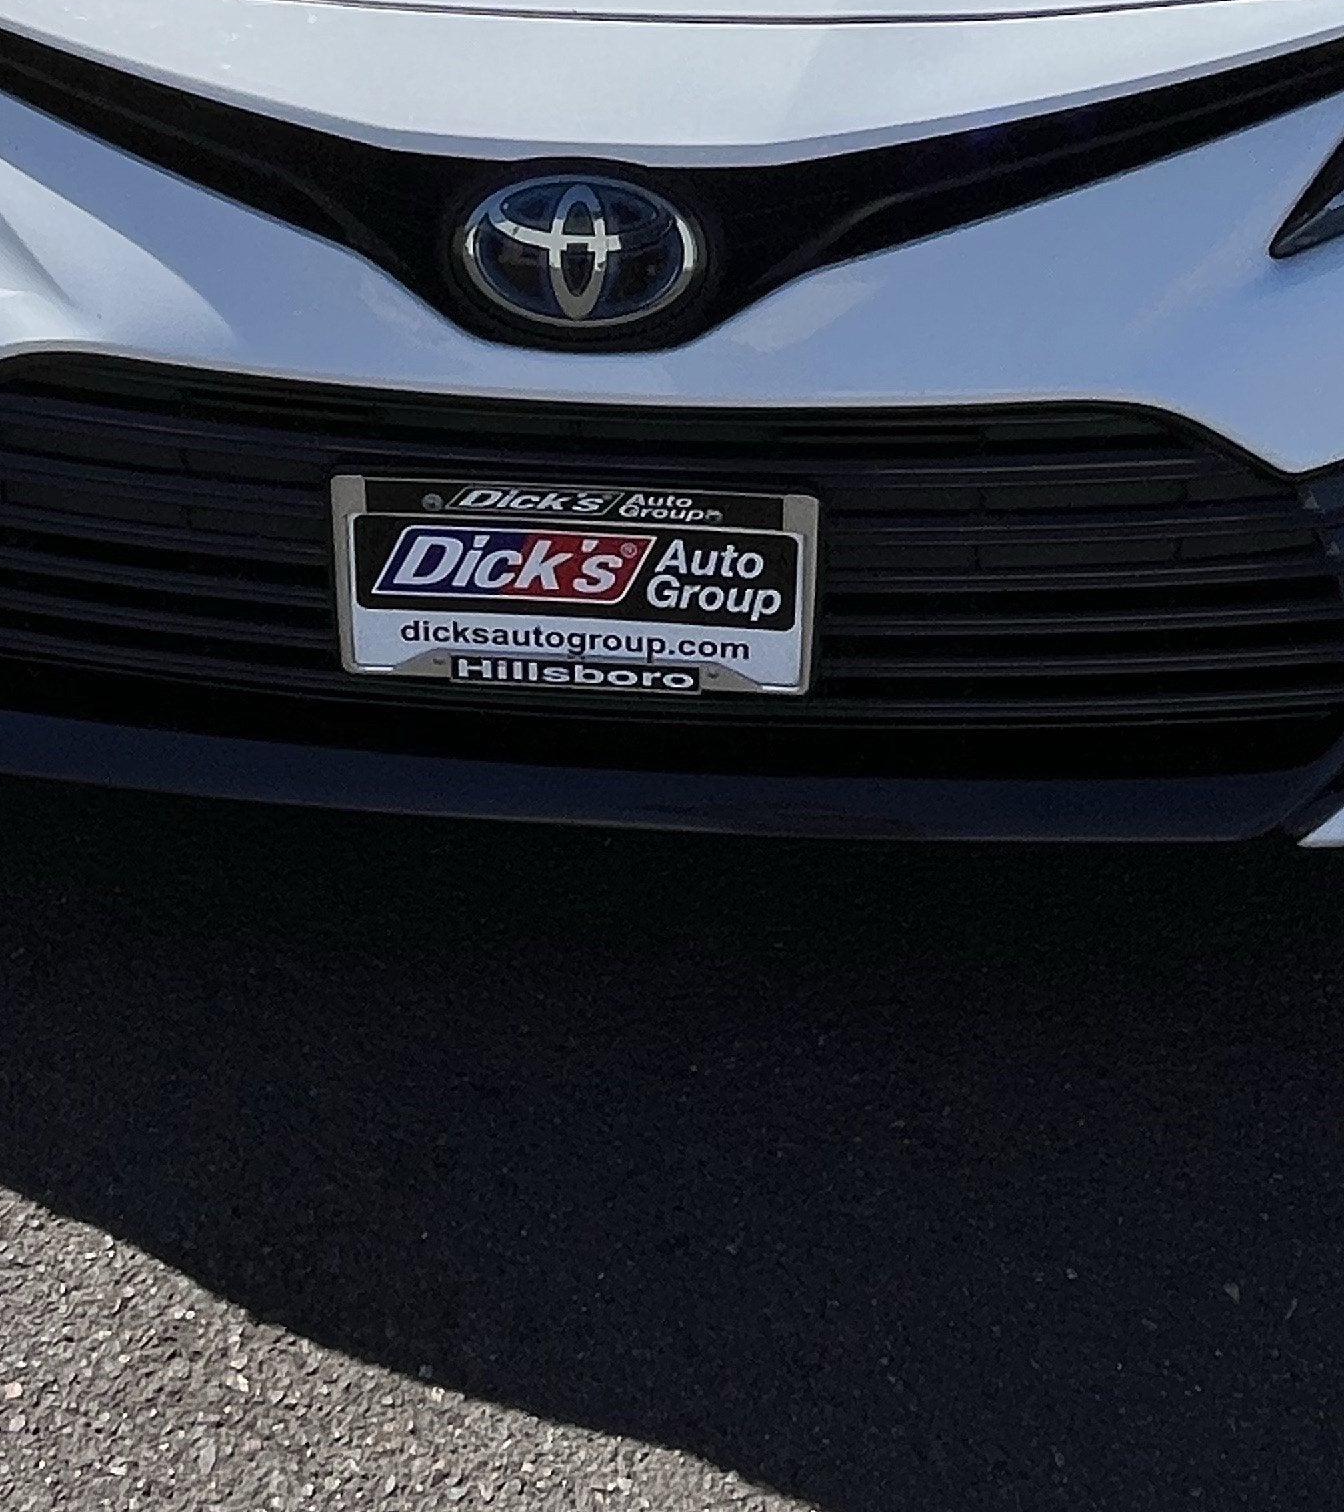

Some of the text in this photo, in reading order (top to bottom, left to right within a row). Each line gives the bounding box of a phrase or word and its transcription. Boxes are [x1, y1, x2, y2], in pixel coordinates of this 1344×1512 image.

[458, 489, 692, 513] Dick's Auto
[618, 505, 708, 522] Group
[392, 534, 764, 593] Dick's Auto
[646, 574, 782, 622] Group
[400, 621, 750, 663] dicksautogroup.com
[457, 657, 695, 689] Hillsboro
